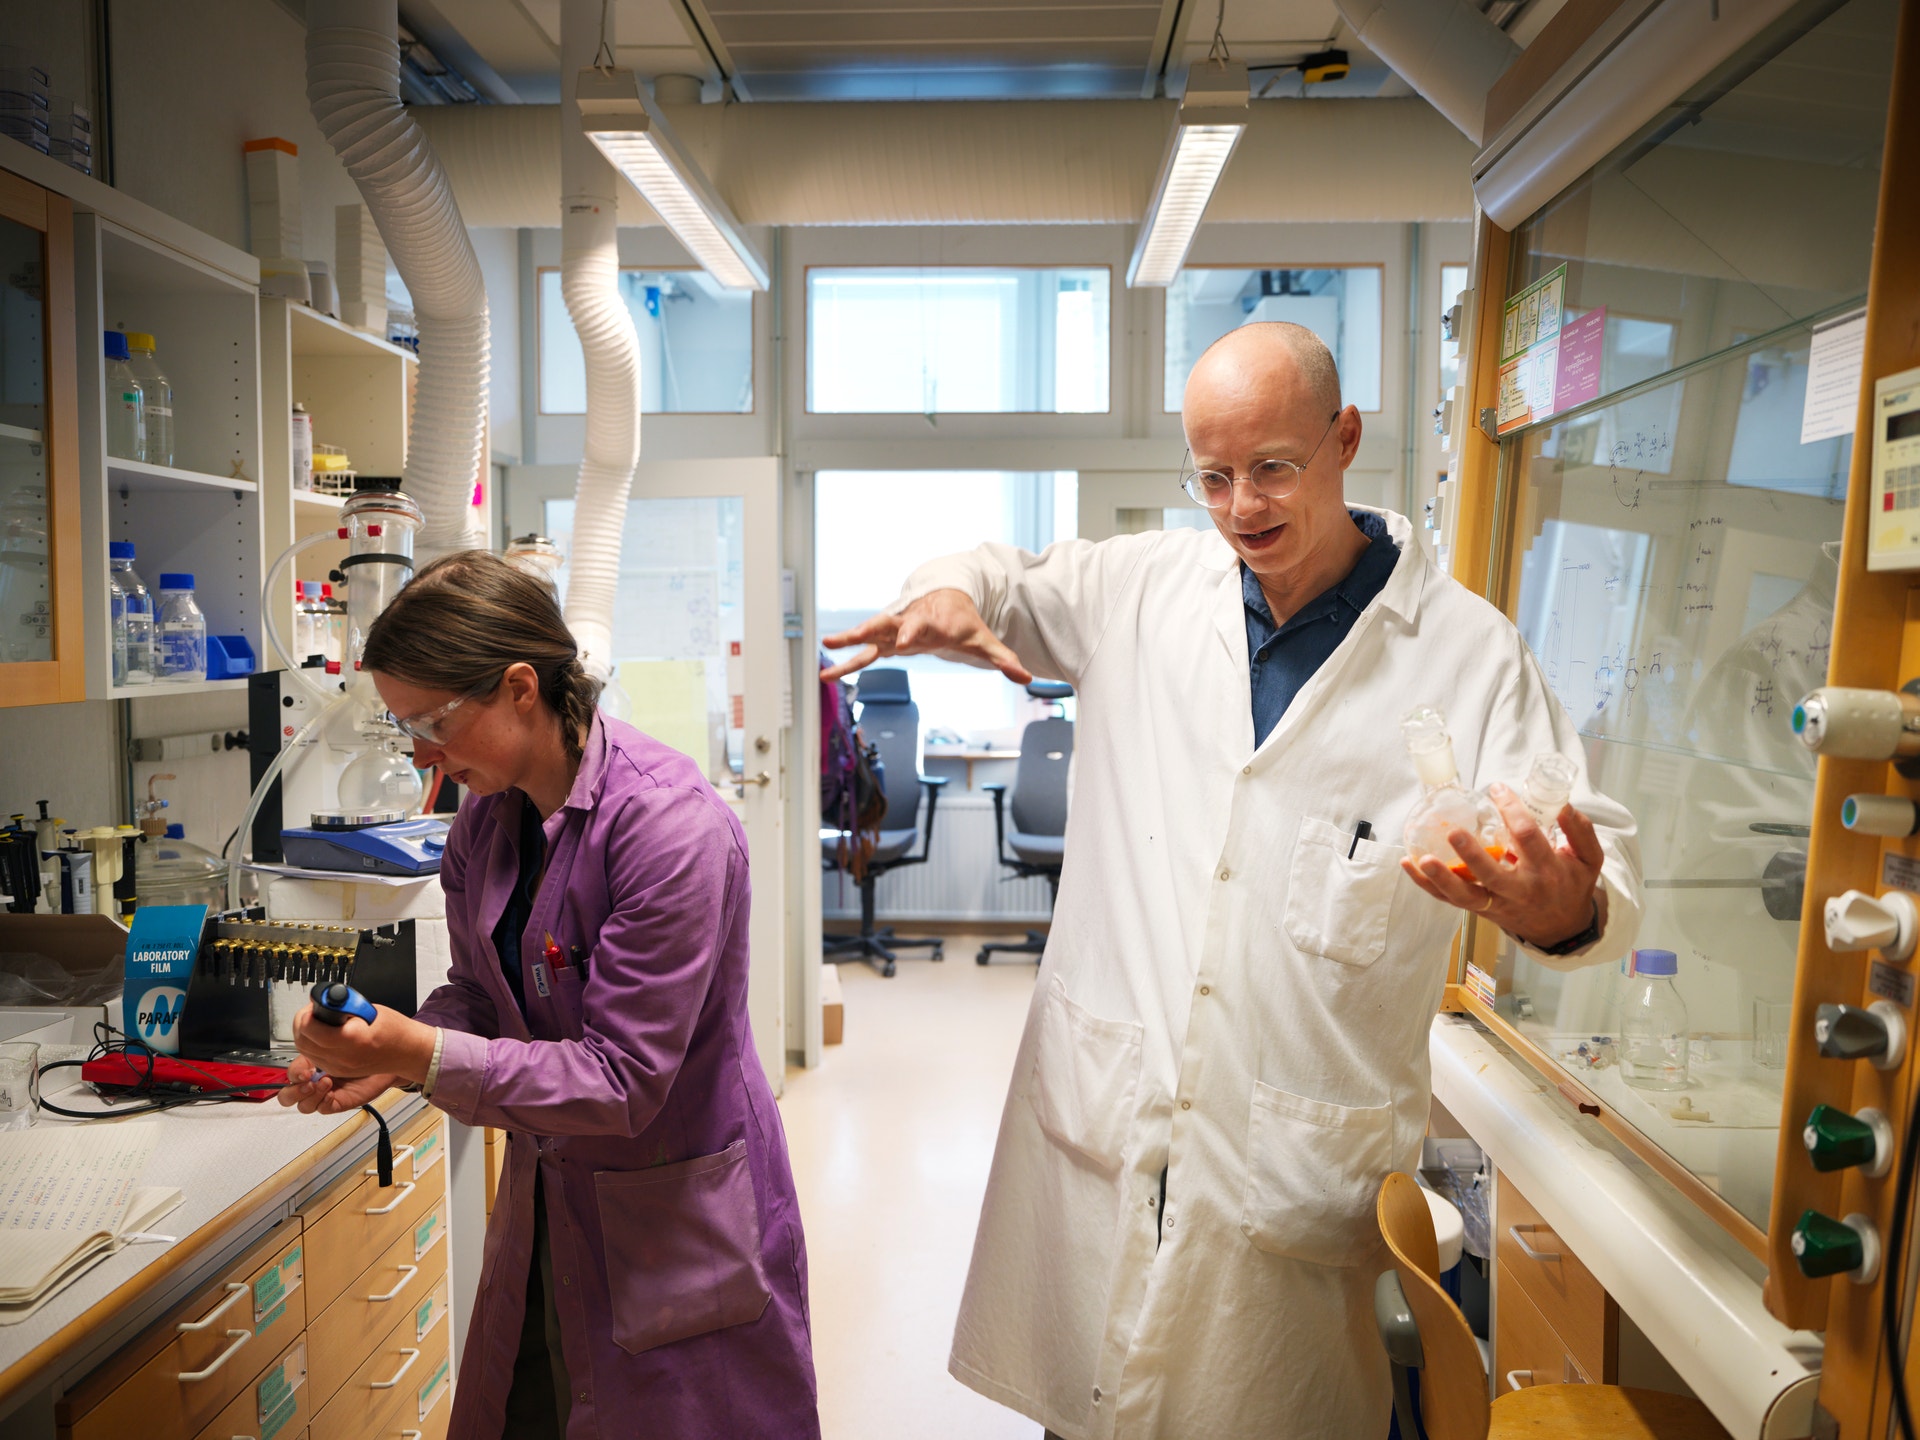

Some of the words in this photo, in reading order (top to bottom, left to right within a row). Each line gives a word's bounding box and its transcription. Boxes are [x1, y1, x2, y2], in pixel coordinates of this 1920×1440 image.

[133, 950, 190, 962] LABORATORY
[151, 962, 171, 973] FILM
[138, 1012, 178, 1025] PARAF
